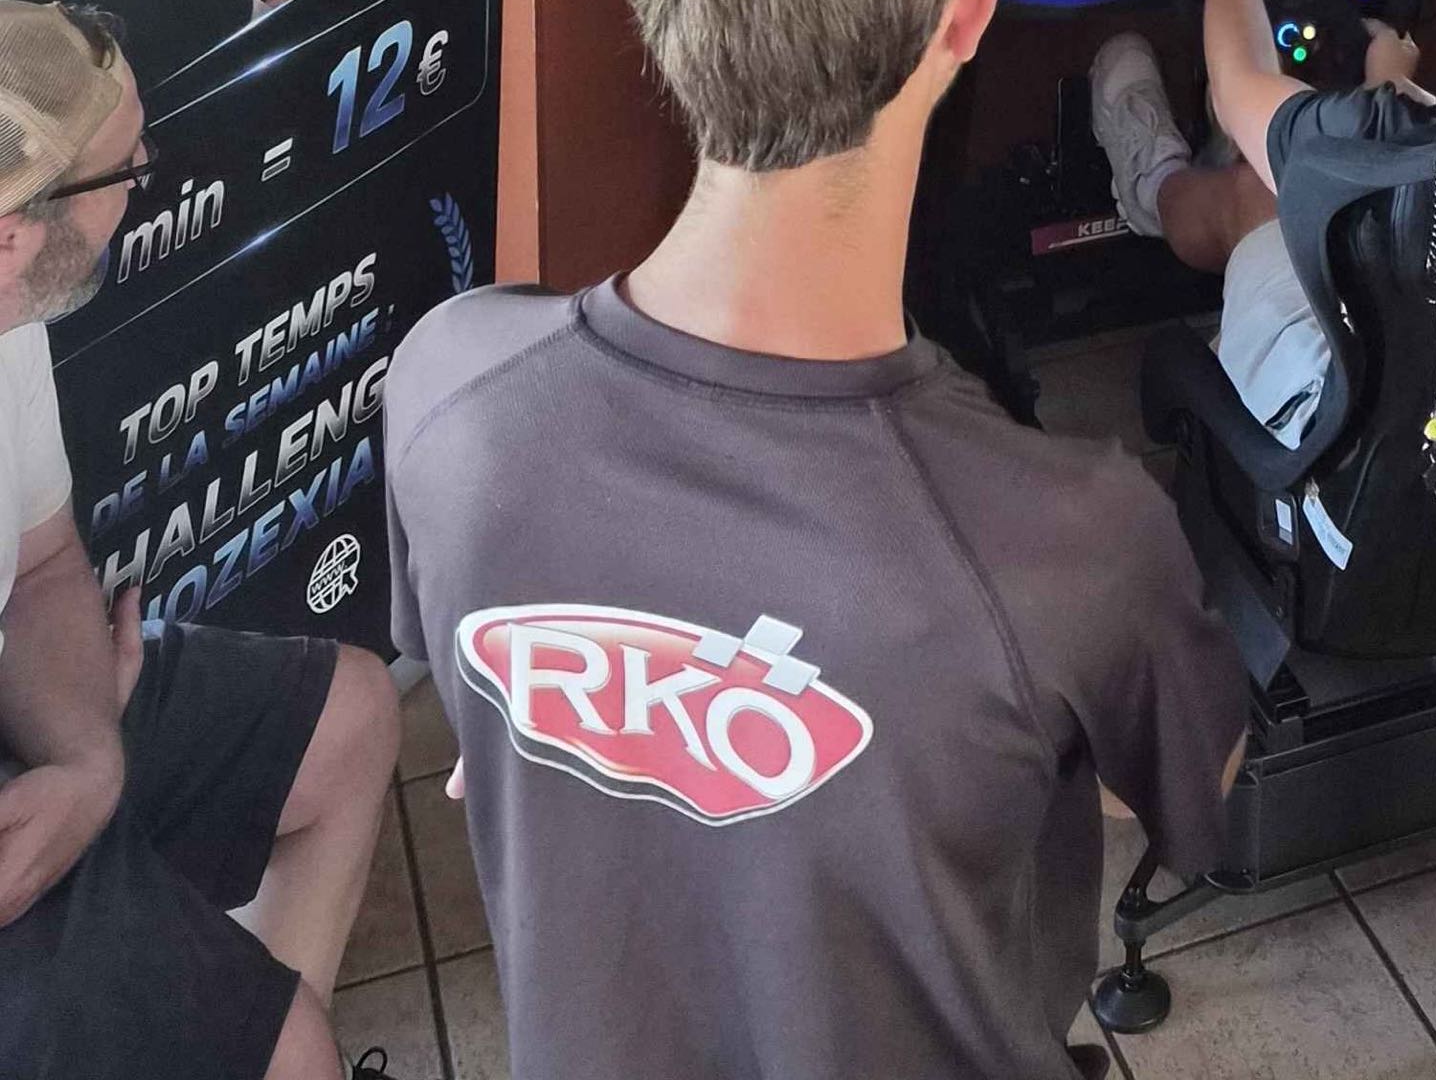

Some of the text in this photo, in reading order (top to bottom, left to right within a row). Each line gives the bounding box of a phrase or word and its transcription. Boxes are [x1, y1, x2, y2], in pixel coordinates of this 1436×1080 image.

[116, 177, 225, 285] min
[91, 470, 148, 535] DE
[158, 429, 210, 494] LA
[222, 306, 380, 448] SEMAINE
[119, 252, 377, 465] TOP TEMPS
[92, 355, 391, 614] HALLENG
[507, 621, 817, 801] RKO
